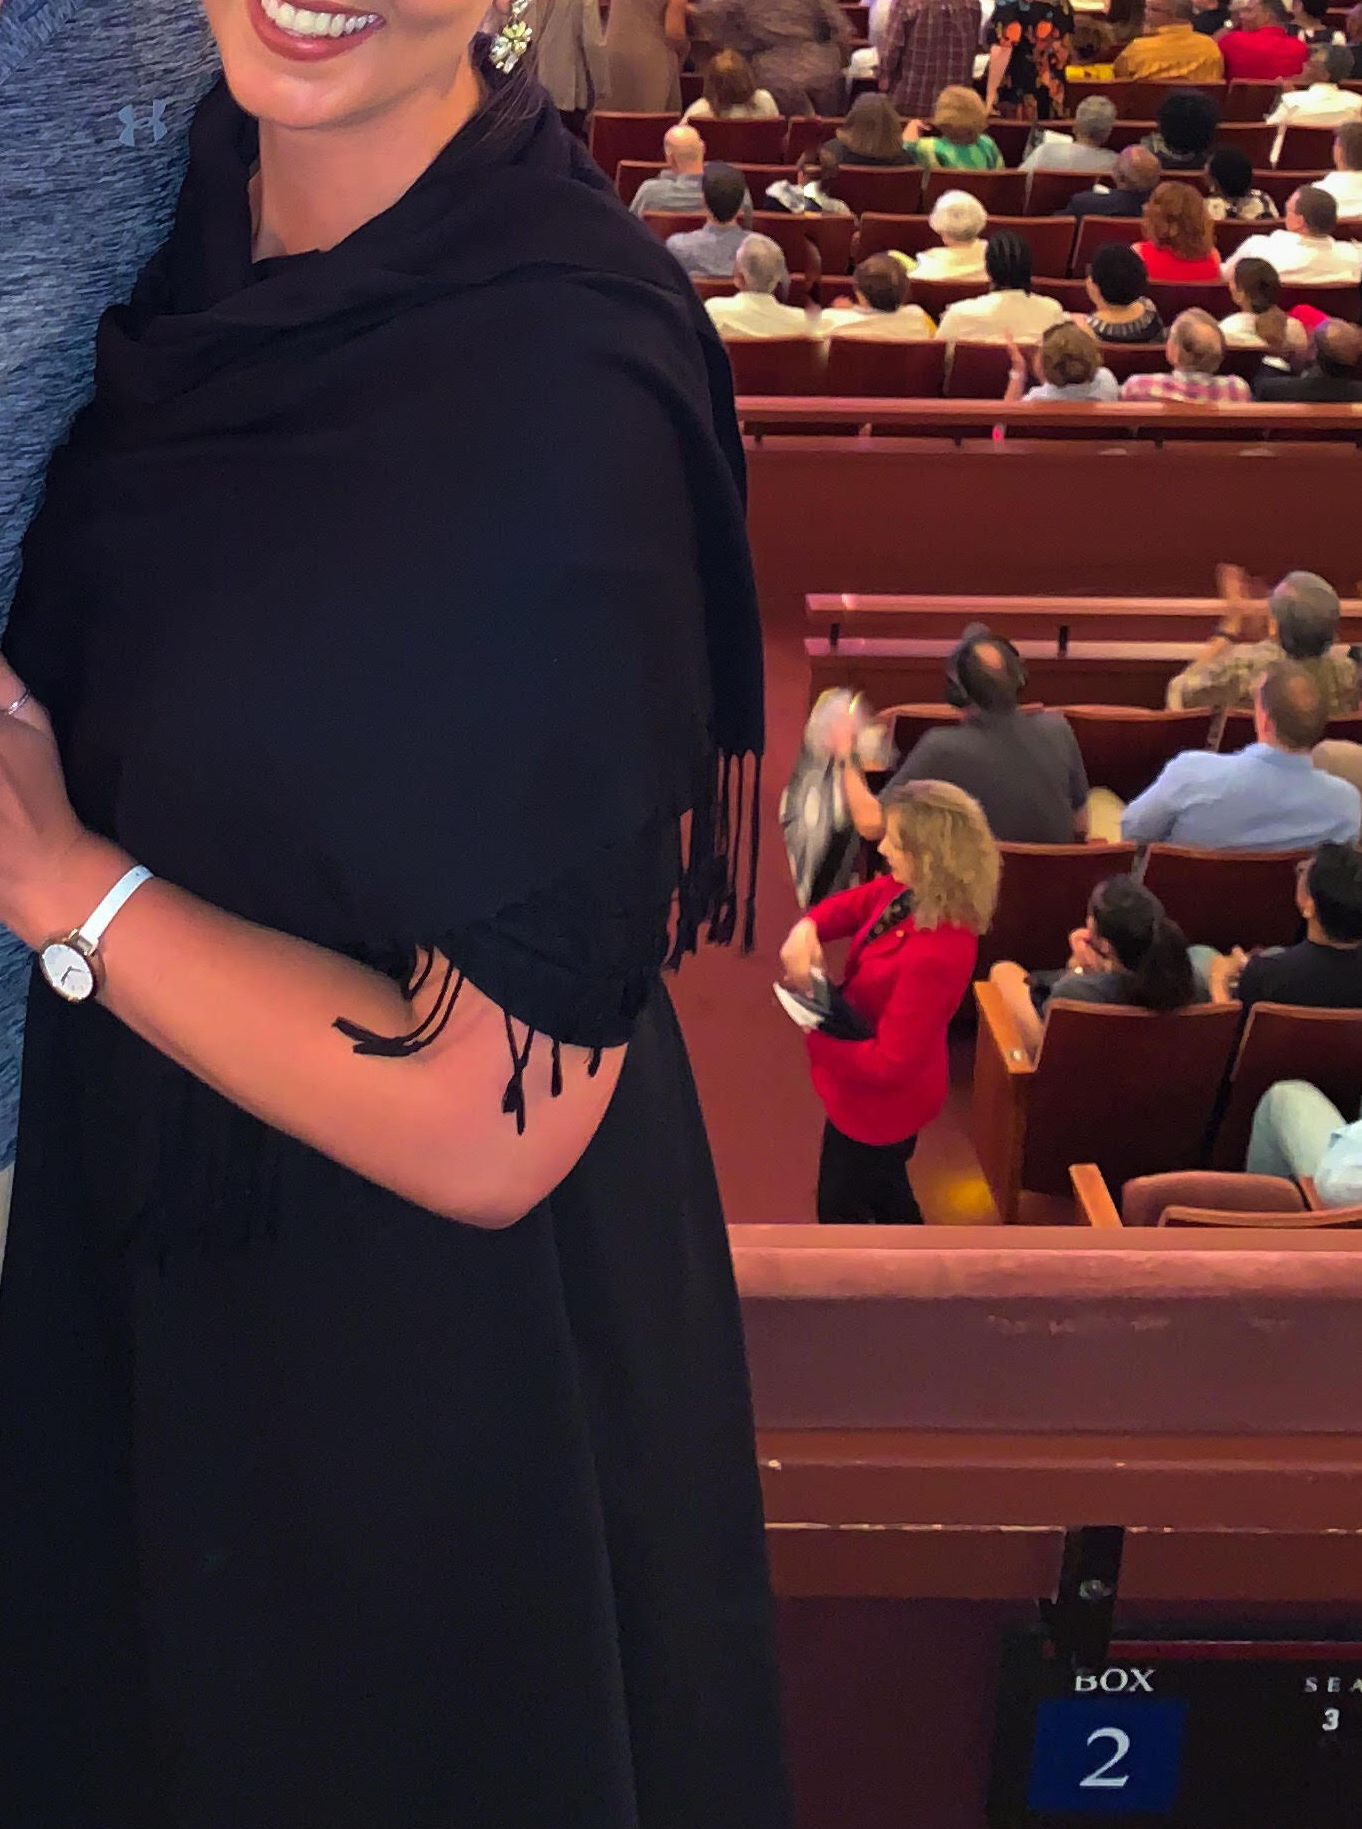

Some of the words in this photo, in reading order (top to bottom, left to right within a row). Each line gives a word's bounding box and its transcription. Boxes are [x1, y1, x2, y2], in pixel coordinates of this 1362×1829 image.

[1074, 1667, 1156, 1692] BOX
[1322, 1707, 1341, 1731] 3
[1079, 1727, 1131, 1787] 2
